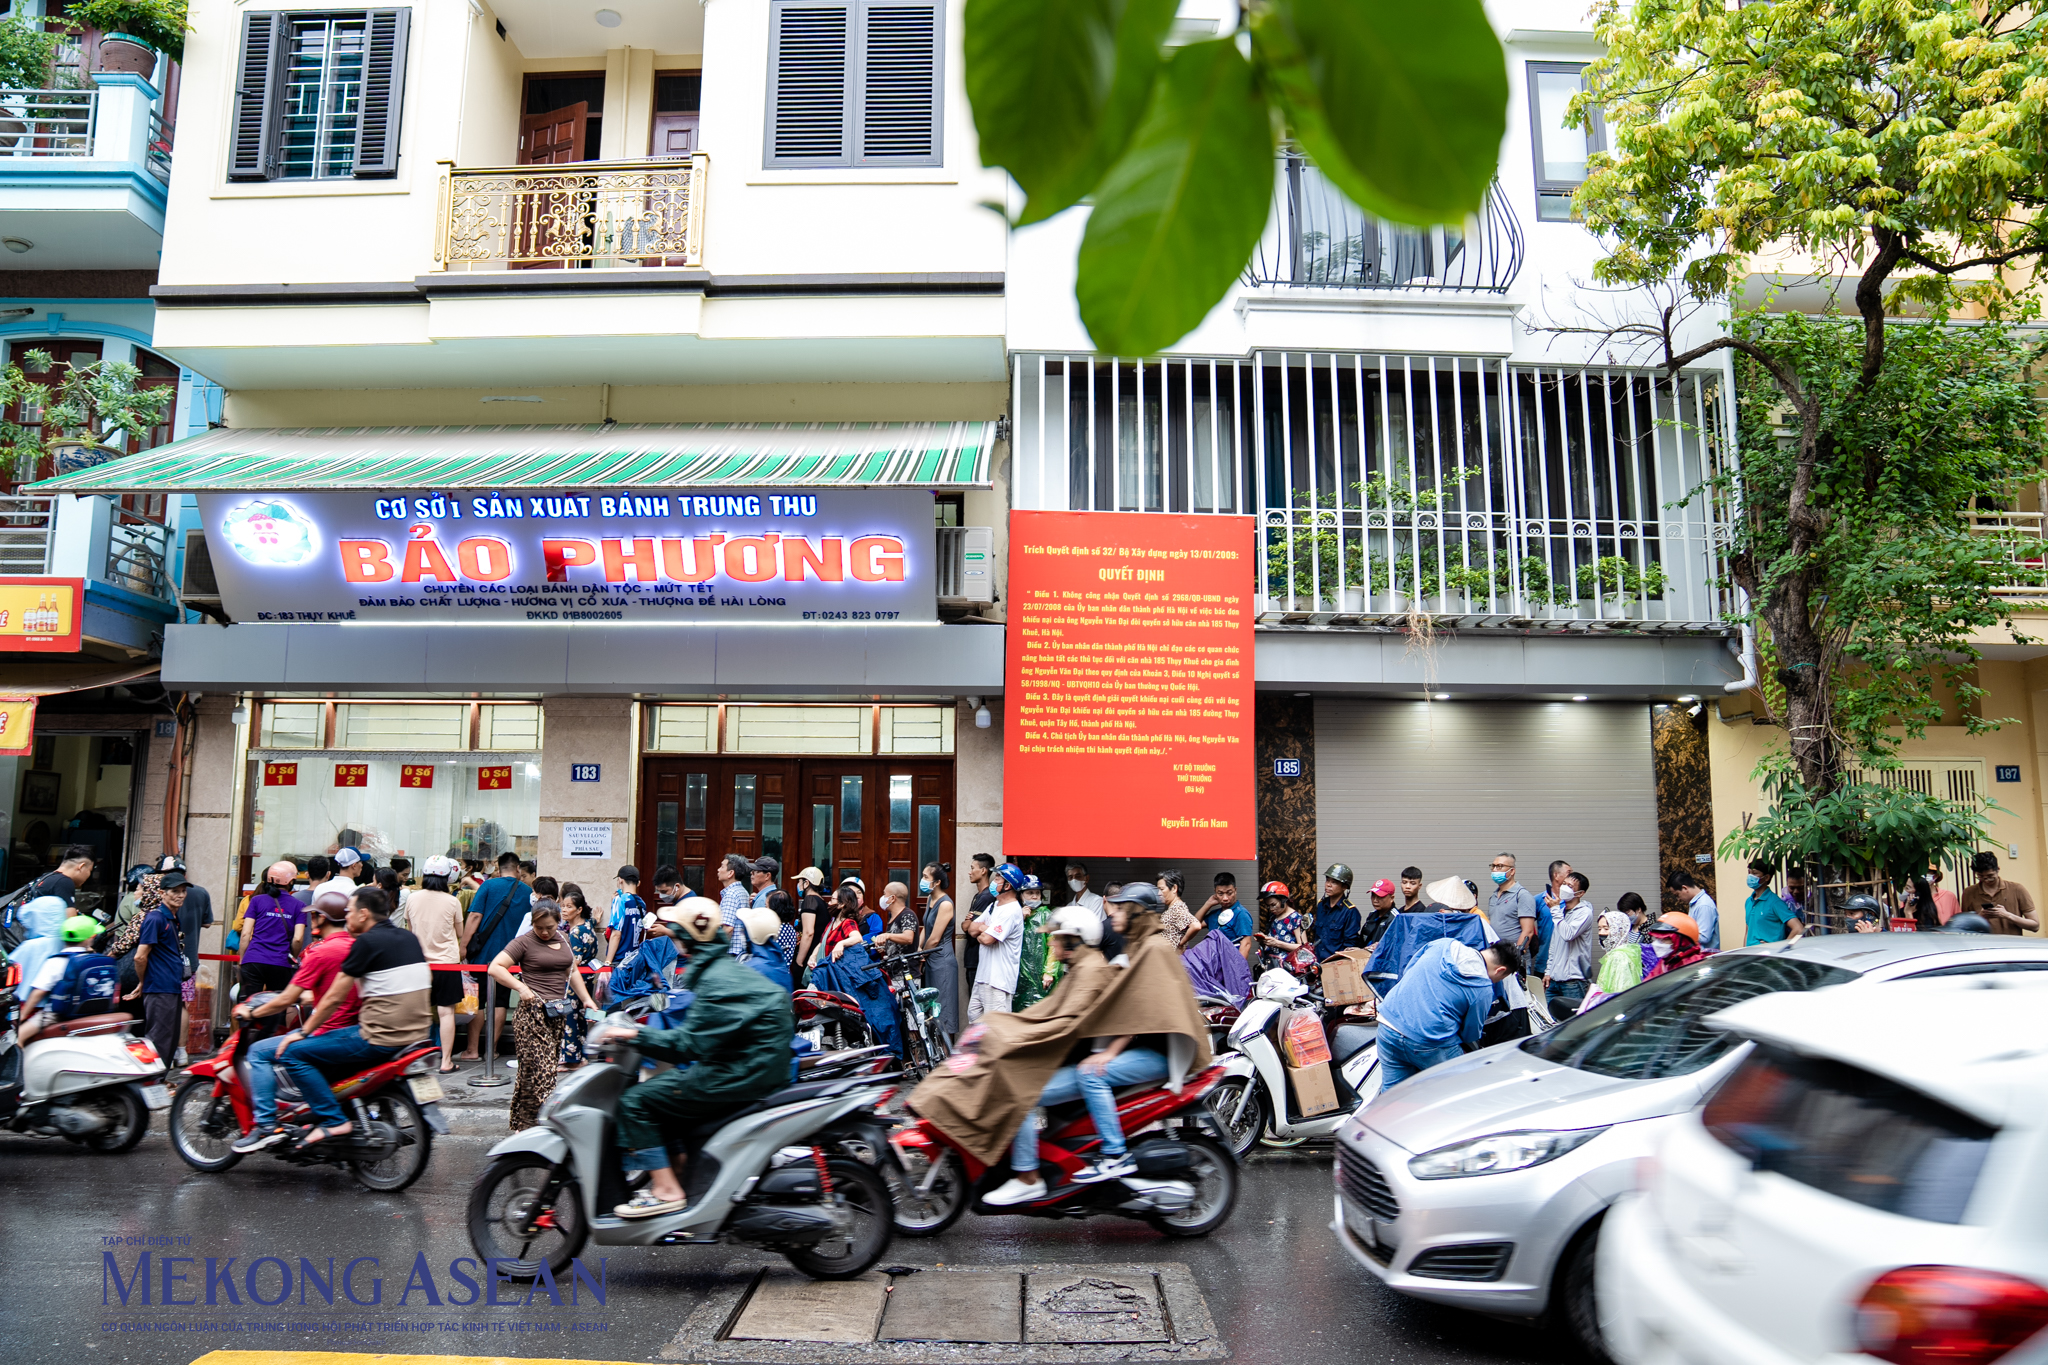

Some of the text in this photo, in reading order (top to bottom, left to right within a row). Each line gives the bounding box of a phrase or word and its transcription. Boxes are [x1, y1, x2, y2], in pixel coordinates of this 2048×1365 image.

[375, 496, 408, 520] CƠ
[414, 491, 447, 519] SỞ
[472, 491, 525, 519] SẢN
[600, 491, 671, 518] BÁNH
[677, 495, 761, 517] TRUNG
[767, 495, 818, 517] THU
[338, 521, 907, 583] BẢO PHƯƠNG
[1023, 545, 1044, 553] Trích
[1046, 546, 1069, 555] Quyết
[1071, 547, 1089, 556] định
[1091, 547, 1100, 555] số
[1119, 548, 1129, 557] Bộ
[1131, 548, 1145, 557] Xây
[1147, 548, 1167, 558] dựng
[1169, 549, 1188, 559] ngày
[1098, 565, 1164, 583] QUYẾT ĐỊNH
[423, 583, 475, 594] CHUYÊN
[479, 583, 506, 594] CÁC
[509, 585, 539, 596] LOẠI
[541, 583, 578, 594] BÁNH
[613, 582, 642, 596] TỘC
[654, 582, 683, 593] MỨT
[390, 595, 416, 607] BẢO
[420, 594, 453, 607] CHẤT
[458, 597, 501, 609] LƯỢNG
[511, 597, 558, 607] HƯƠNG
[560, 598, 574, 609] VỊ
[578, 592, 598, 607] CỔ
[602, 597, 629, 607] XƯA
[640, 597, 695, 609] THƯỢNG
[721, 595, 744, 606] HÀI
[749, 595, 787, 606] LÒNG
[562, 611, 623, 620] 01B8002605
[851, 611, 871, 620] 823
[874, 611, 900, 620] 0797
[158, 722, 177, 734] 18
[574, 766, 597, 779] 183
[1277, 761, 1298, 773] 185
[276, 775, 283, 784] 1
[1999, 768, 2017, 779] 187
[346, 776, 356, 785] 2
[412, 777, 421, 786] 3
[489, 778, 499, 788] 4
[1161, 816, 1227, 828] Nguyễn Trần Nam
